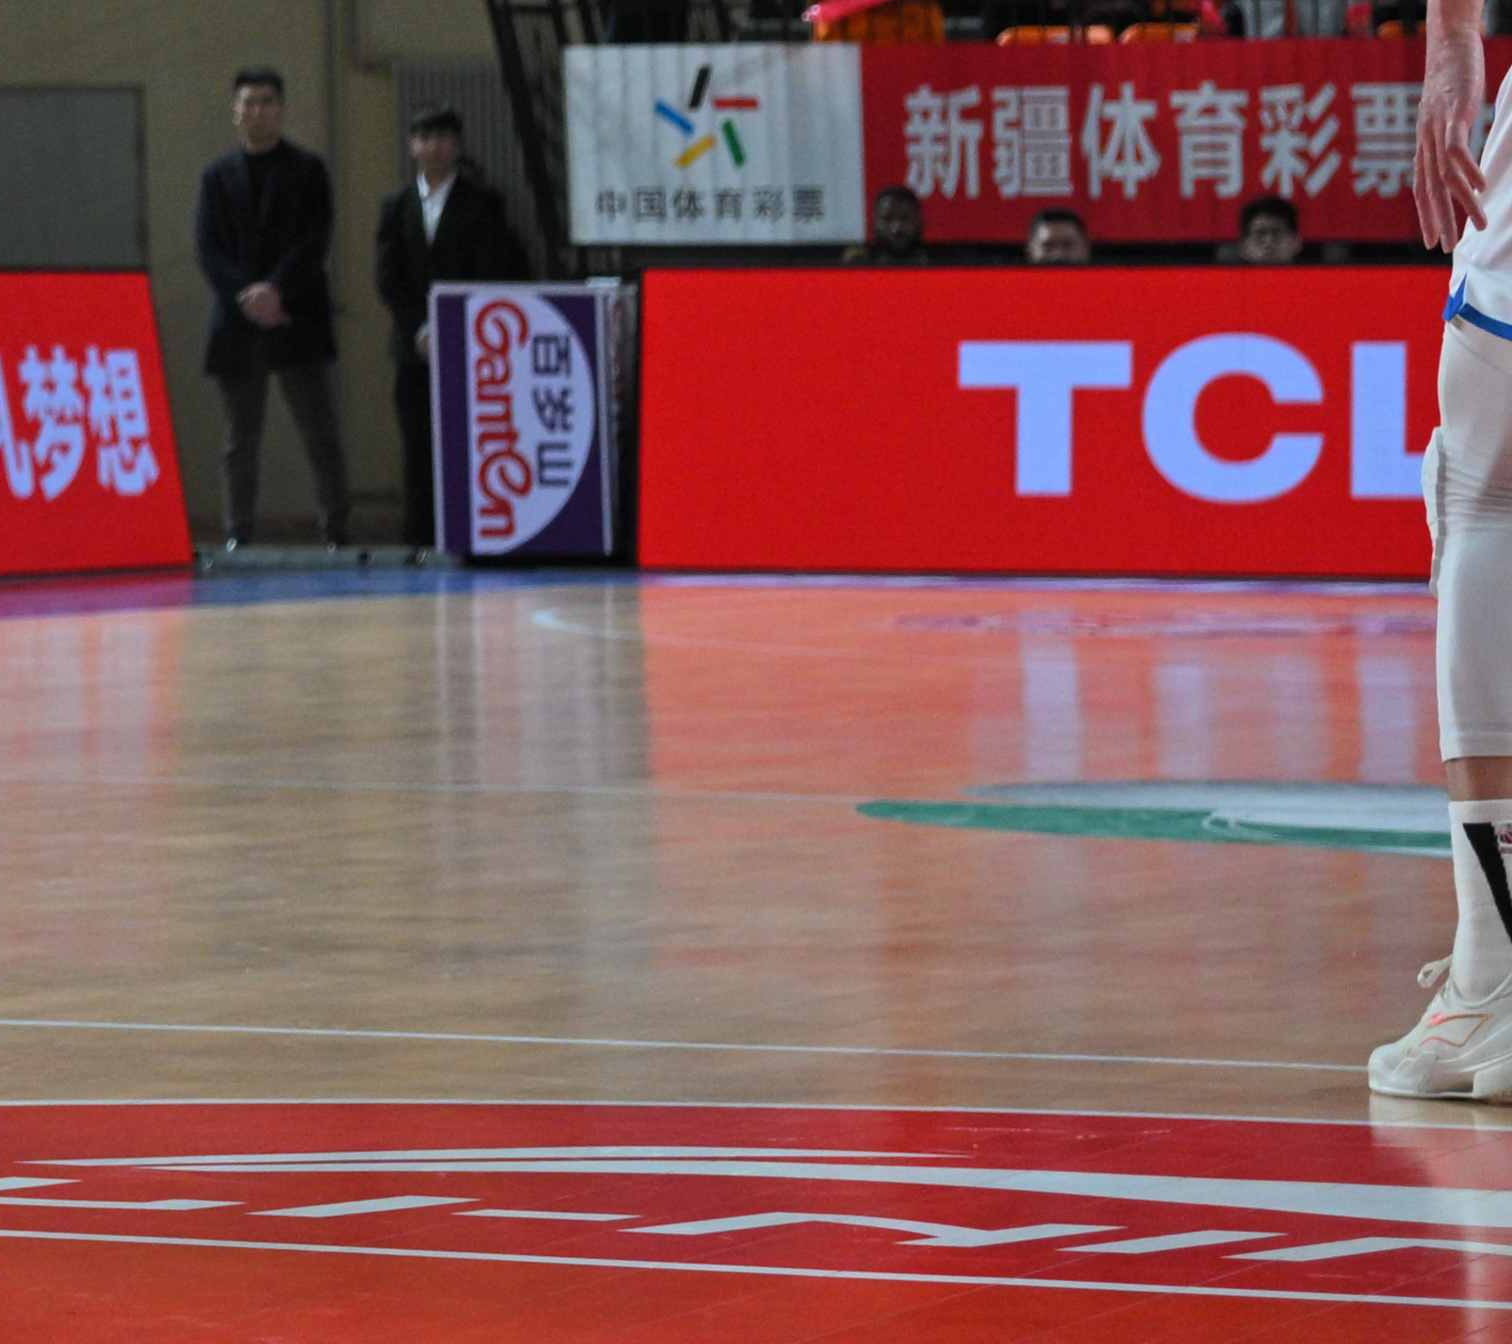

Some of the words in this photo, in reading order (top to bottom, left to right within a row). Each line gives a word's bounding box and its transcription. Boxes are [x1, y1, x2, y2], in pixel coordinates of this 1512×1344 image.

[595, 184, 827, 225] 中国体育彩票
[531, 333, 576, 490] 百岁山
[957, 332, 1424, 505] TCL
